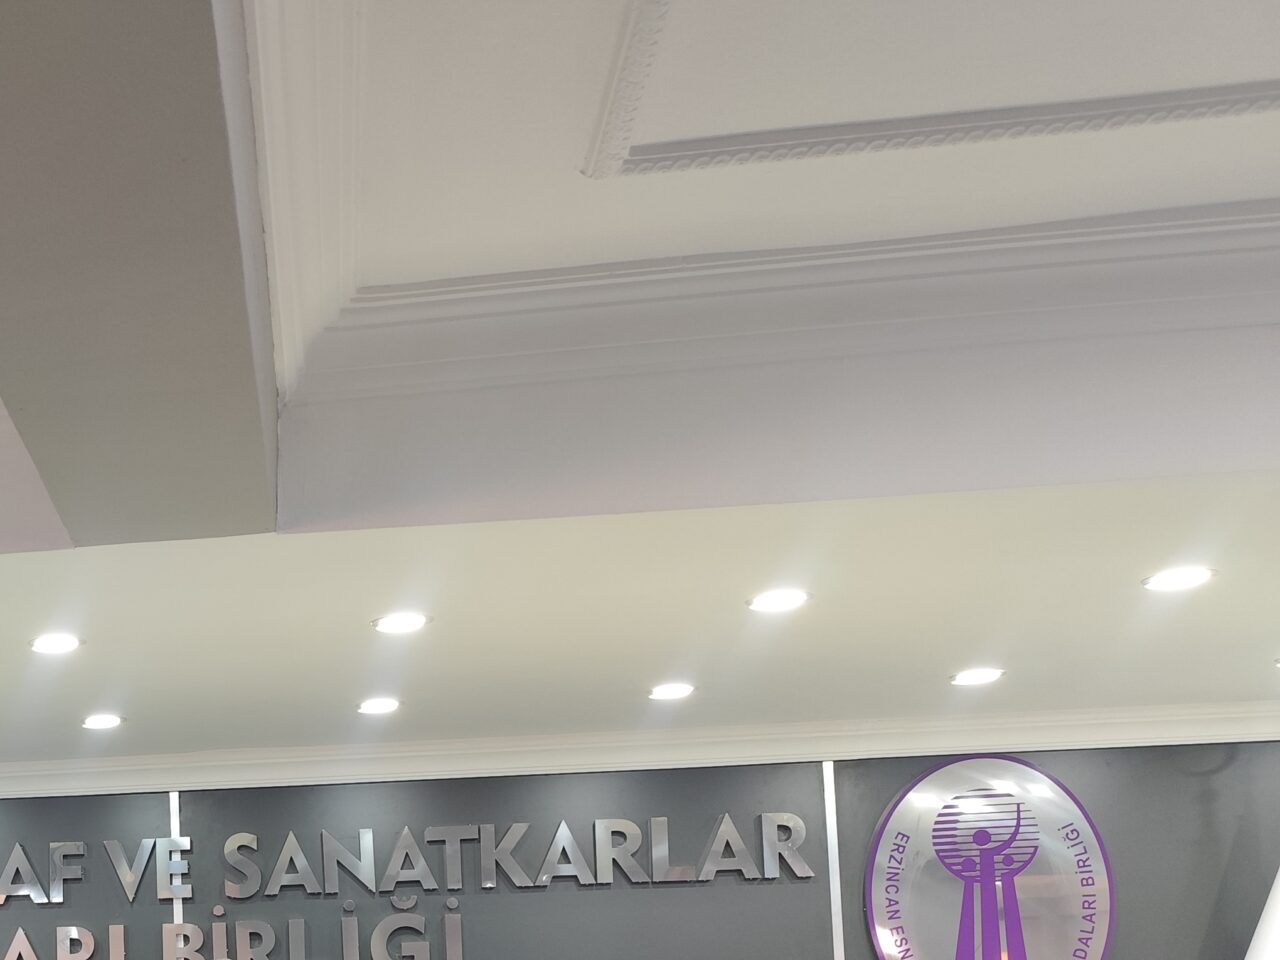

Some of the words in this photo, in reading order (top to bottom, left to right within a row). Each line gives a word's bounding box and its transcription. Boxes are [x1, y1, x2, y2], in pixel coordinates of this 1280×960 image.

[104, 836, 192, 902] VE
[225, 812, 815, 899] SANATKARLAR
[885, 831, 910, 920] ERZİNCAN
[1057, 822, 1096, 887] BİRLİĞİ
